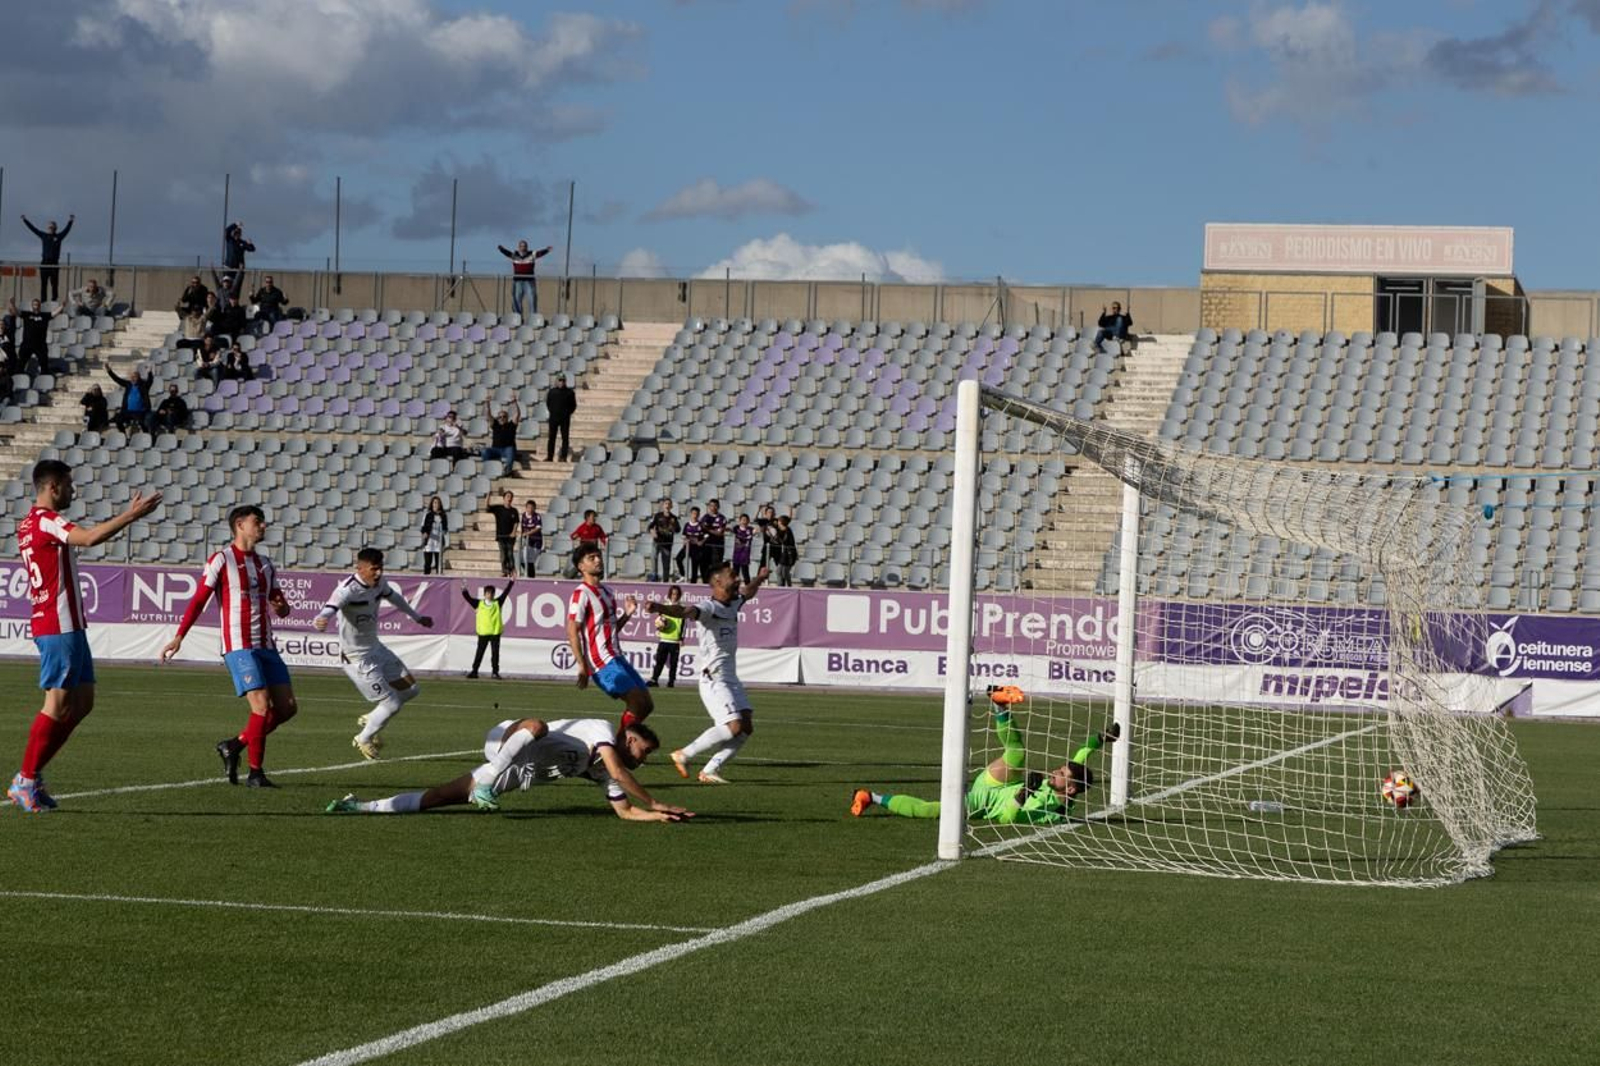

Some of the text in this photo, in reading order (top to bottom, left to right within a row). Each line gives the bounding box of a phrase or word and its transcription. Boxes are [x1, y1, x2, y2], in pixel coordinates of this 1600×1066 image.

[1285, 236, 1432, 261] PERIODISMO EN VIVO
[271, 617, 314, 627] utrition.c
[753, 608, 773, 624] 13
[1046, 639, 1117, 658] Promowe
[827, 652, 909, 675] Blanca
[1048, 661, 1117, 683] Blanc
[372, 682, 382, 695] 9
